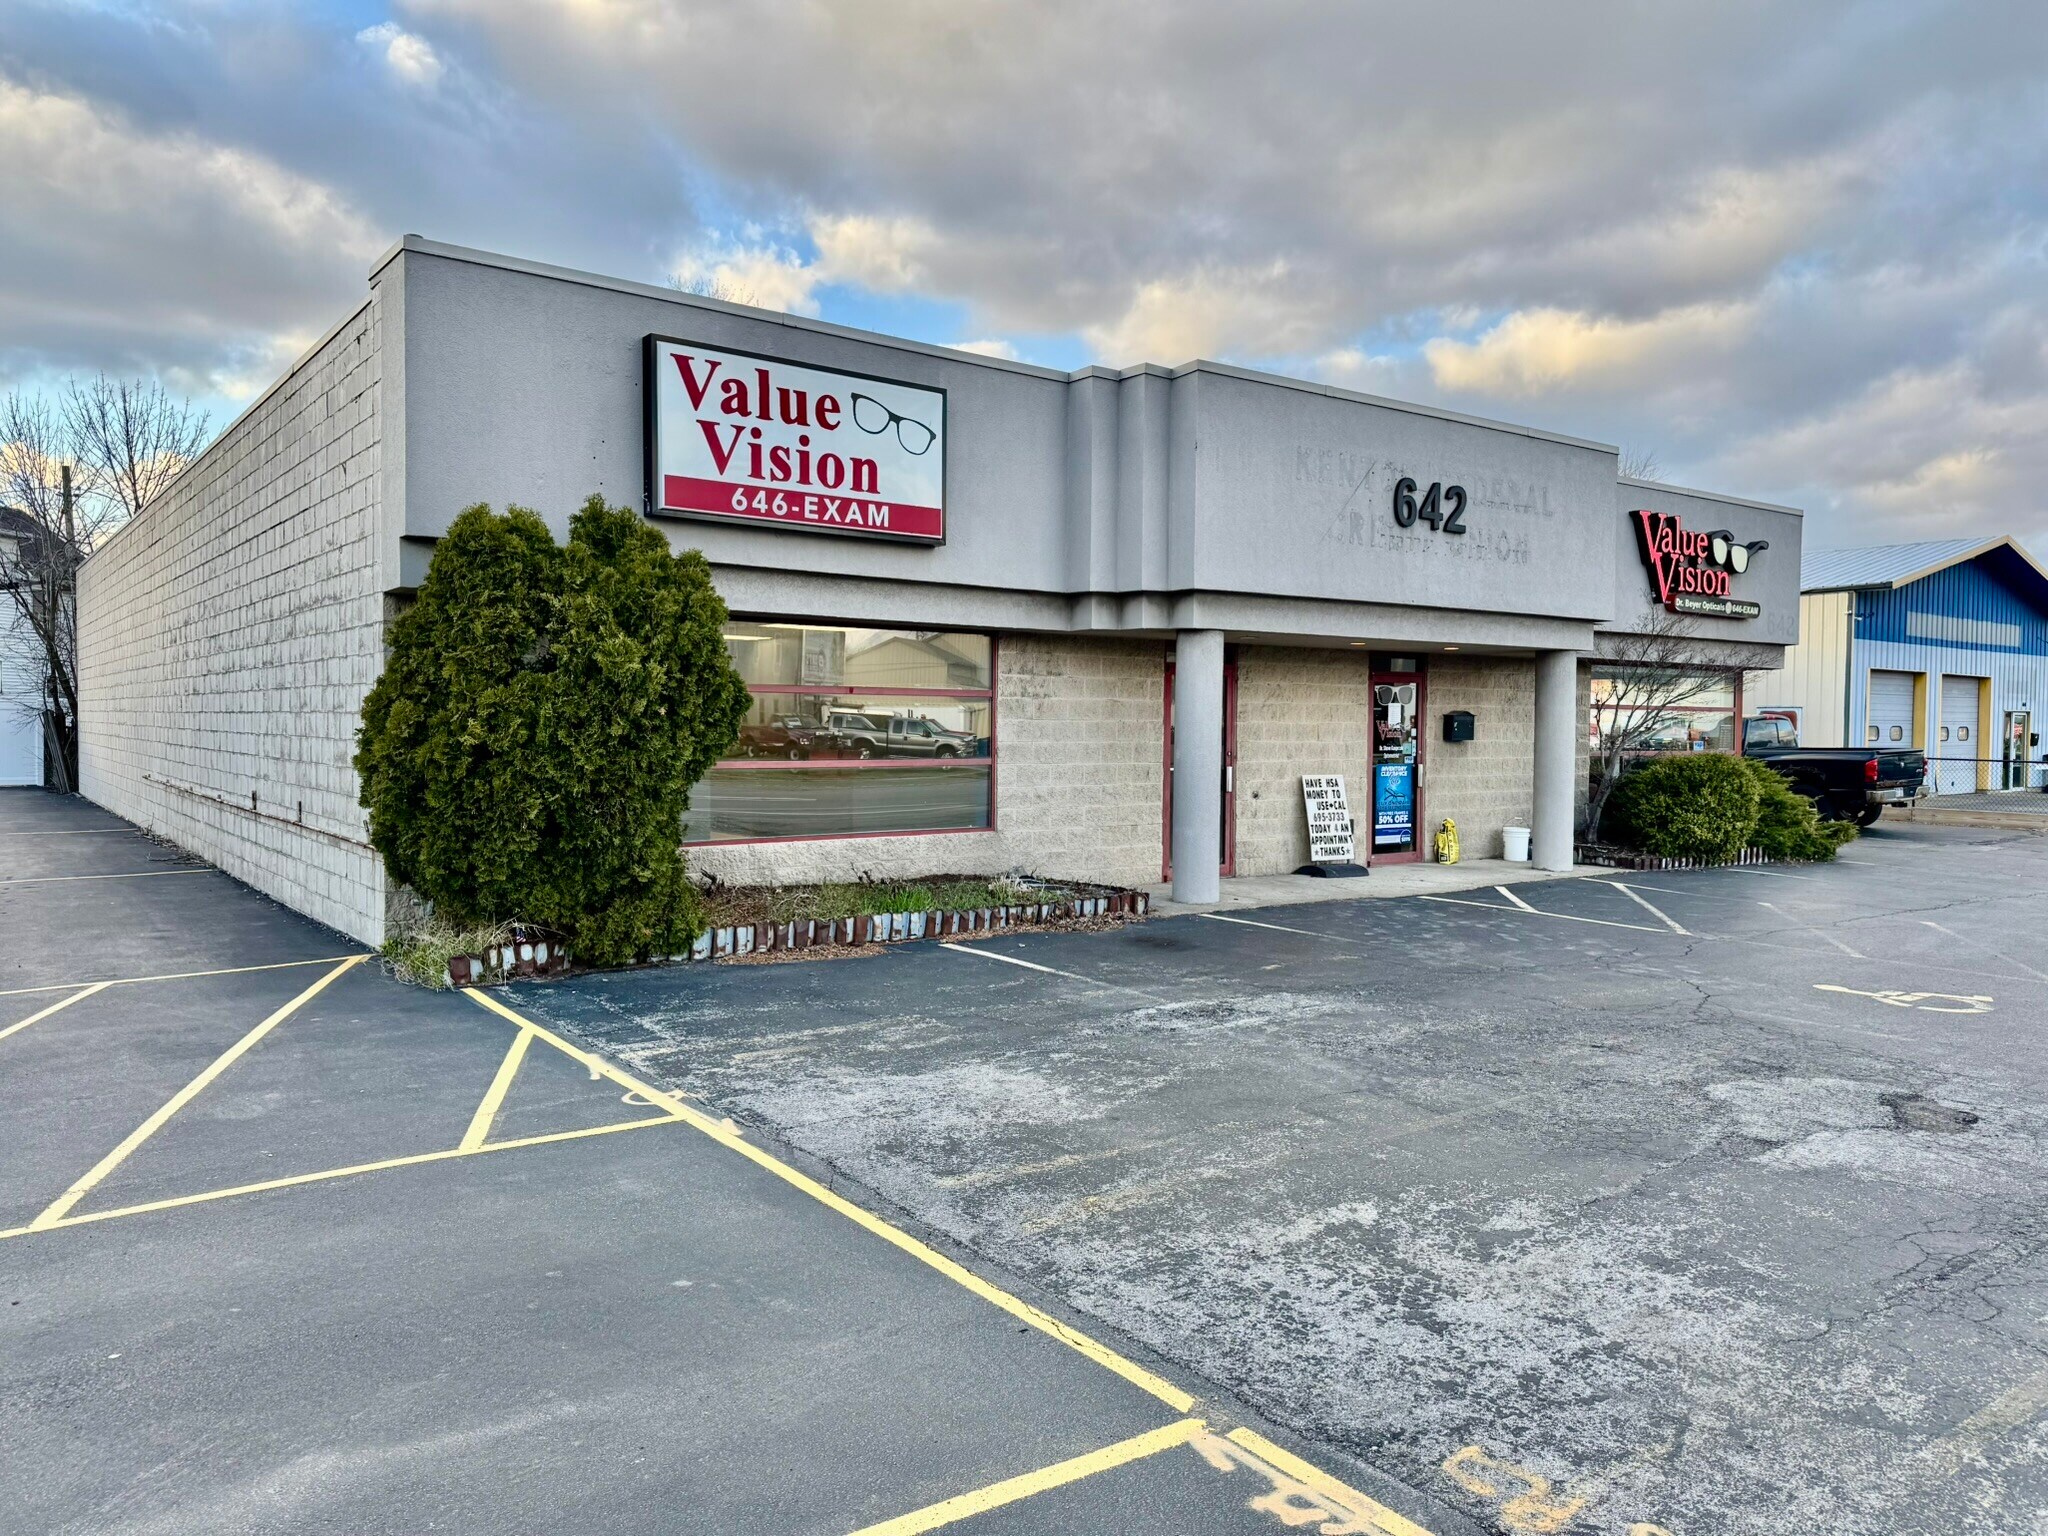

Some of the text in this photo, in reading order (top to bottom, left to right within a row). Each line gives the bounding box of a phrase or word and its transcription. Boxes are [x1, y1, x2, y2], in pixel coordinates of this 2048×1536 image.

[669, 352, 842, 431] Value
[695, 419, 881, 495] Vision
[731, 487, 890, 528] 646-EXAM
[1393, 477, 1468, 535] 642
[1639, 510, 1709, 564] Value
[1652, 552, 1731, 604] Vision
[1675, 597, 1760, 615] Dr. Beyer Opticals 646-EXAM
[1304, 778, 1339, 788] HAVE HSA
[1306, 789, 1341, 799] MONEY TO
[1313, 812, 1345, 822] 695-3733
[1394, 814, 1409, 824] OFF
[1310, 823, 1331, 834] TODAY
[1340, 823, 1349, 833] AN
[1320, 846, 1345, 857] THANKS
